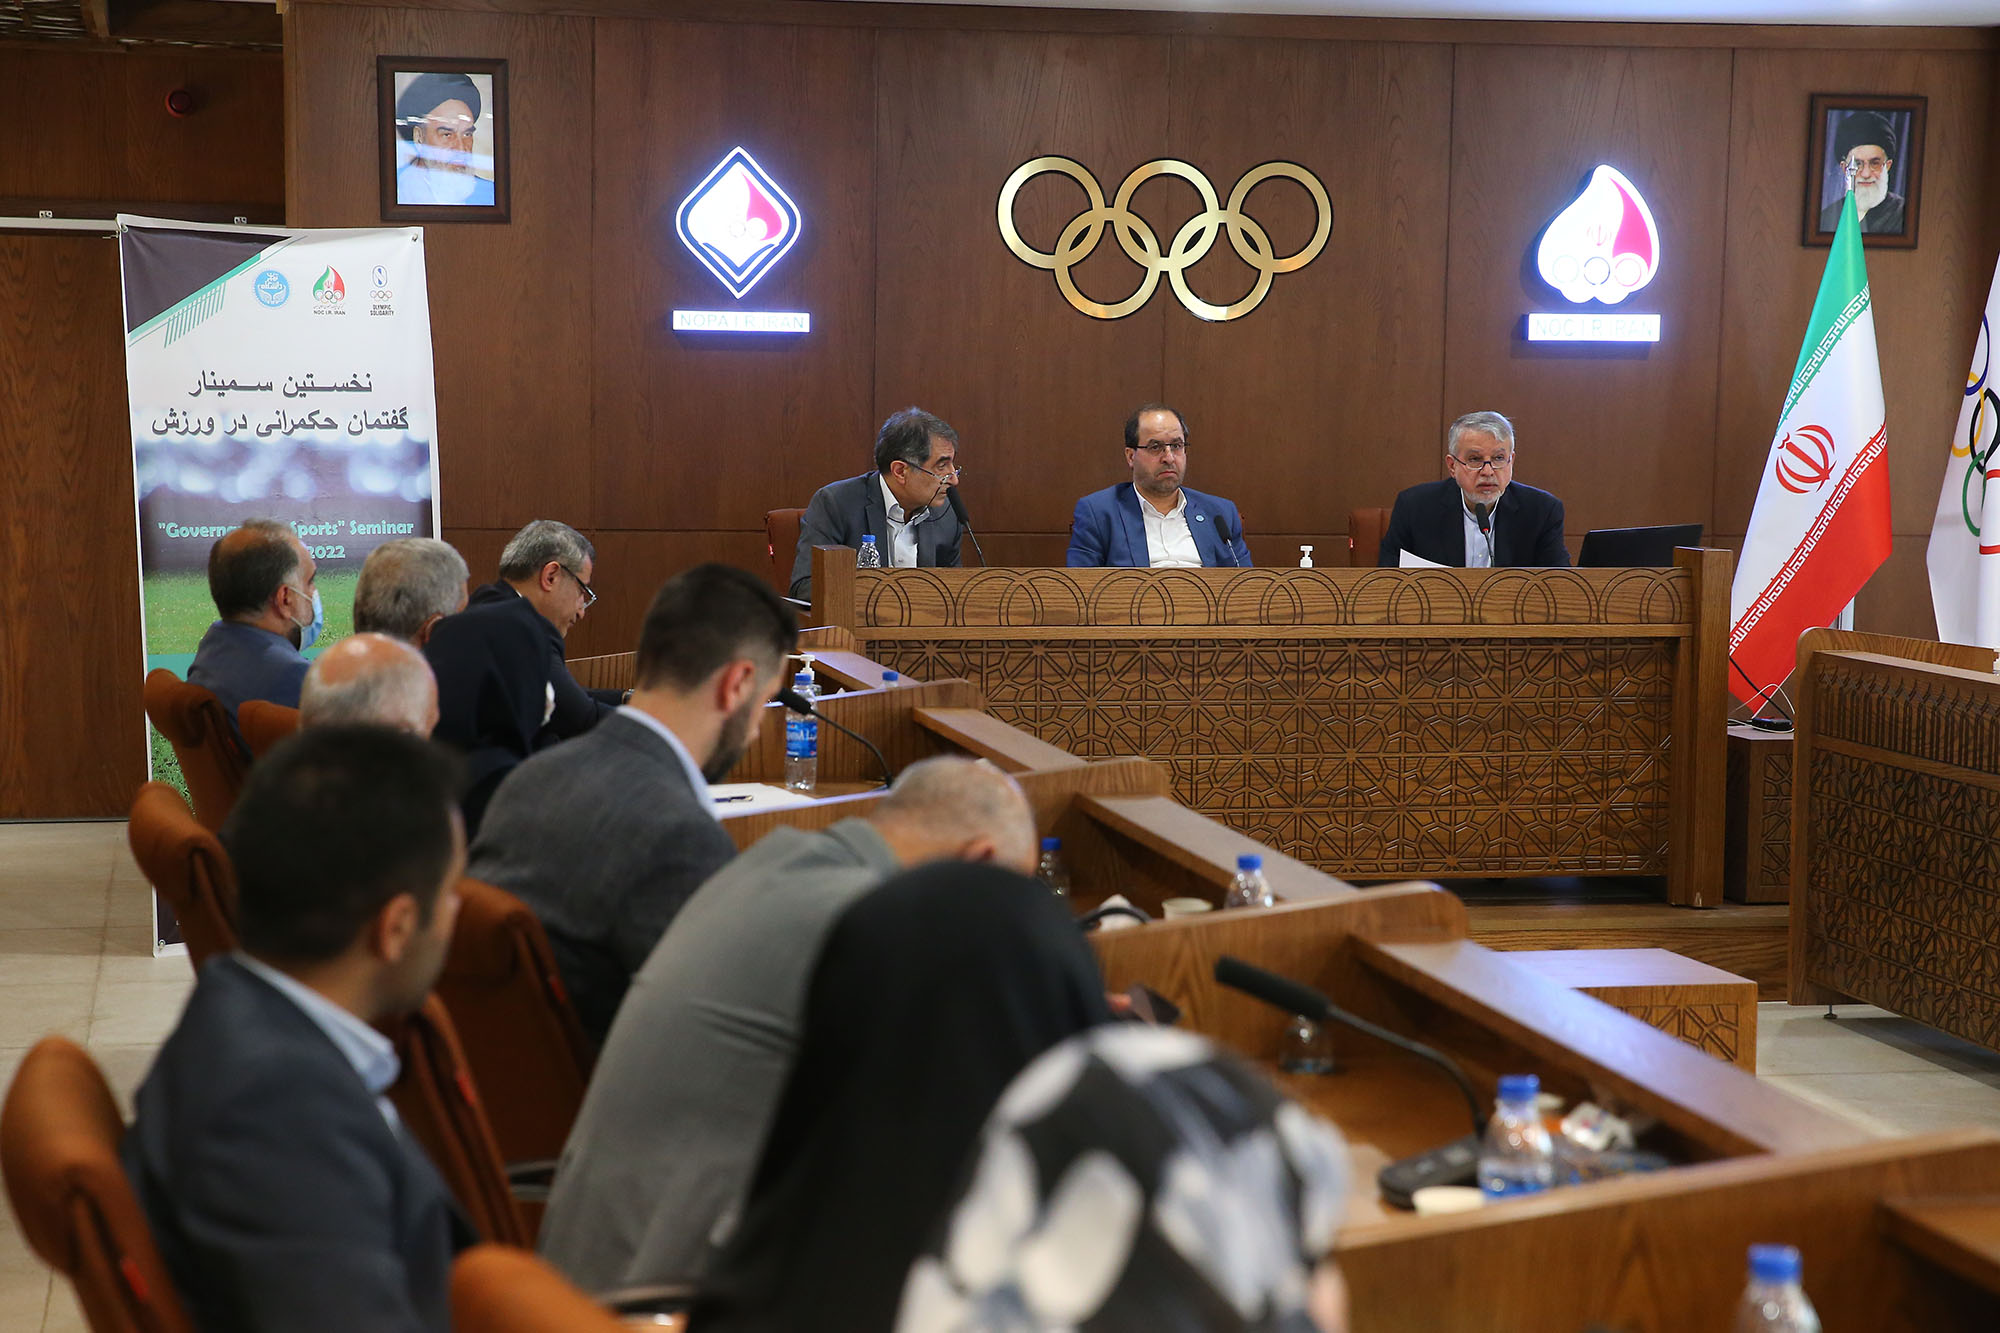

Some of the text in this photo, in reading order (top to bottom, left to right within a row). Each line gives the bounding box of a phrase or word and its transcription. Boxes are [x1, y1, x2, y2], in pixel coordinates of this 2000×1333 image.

[680, 313, 729, 328] NOPA
[1535, 318, 1577, 337] NOC
[188, 369, 373, 398] نخستین سمینار
[151, 406, 409, 437] گفتمان حکمرانی در ورزش
[349, 519, 414, 536] Seminar
